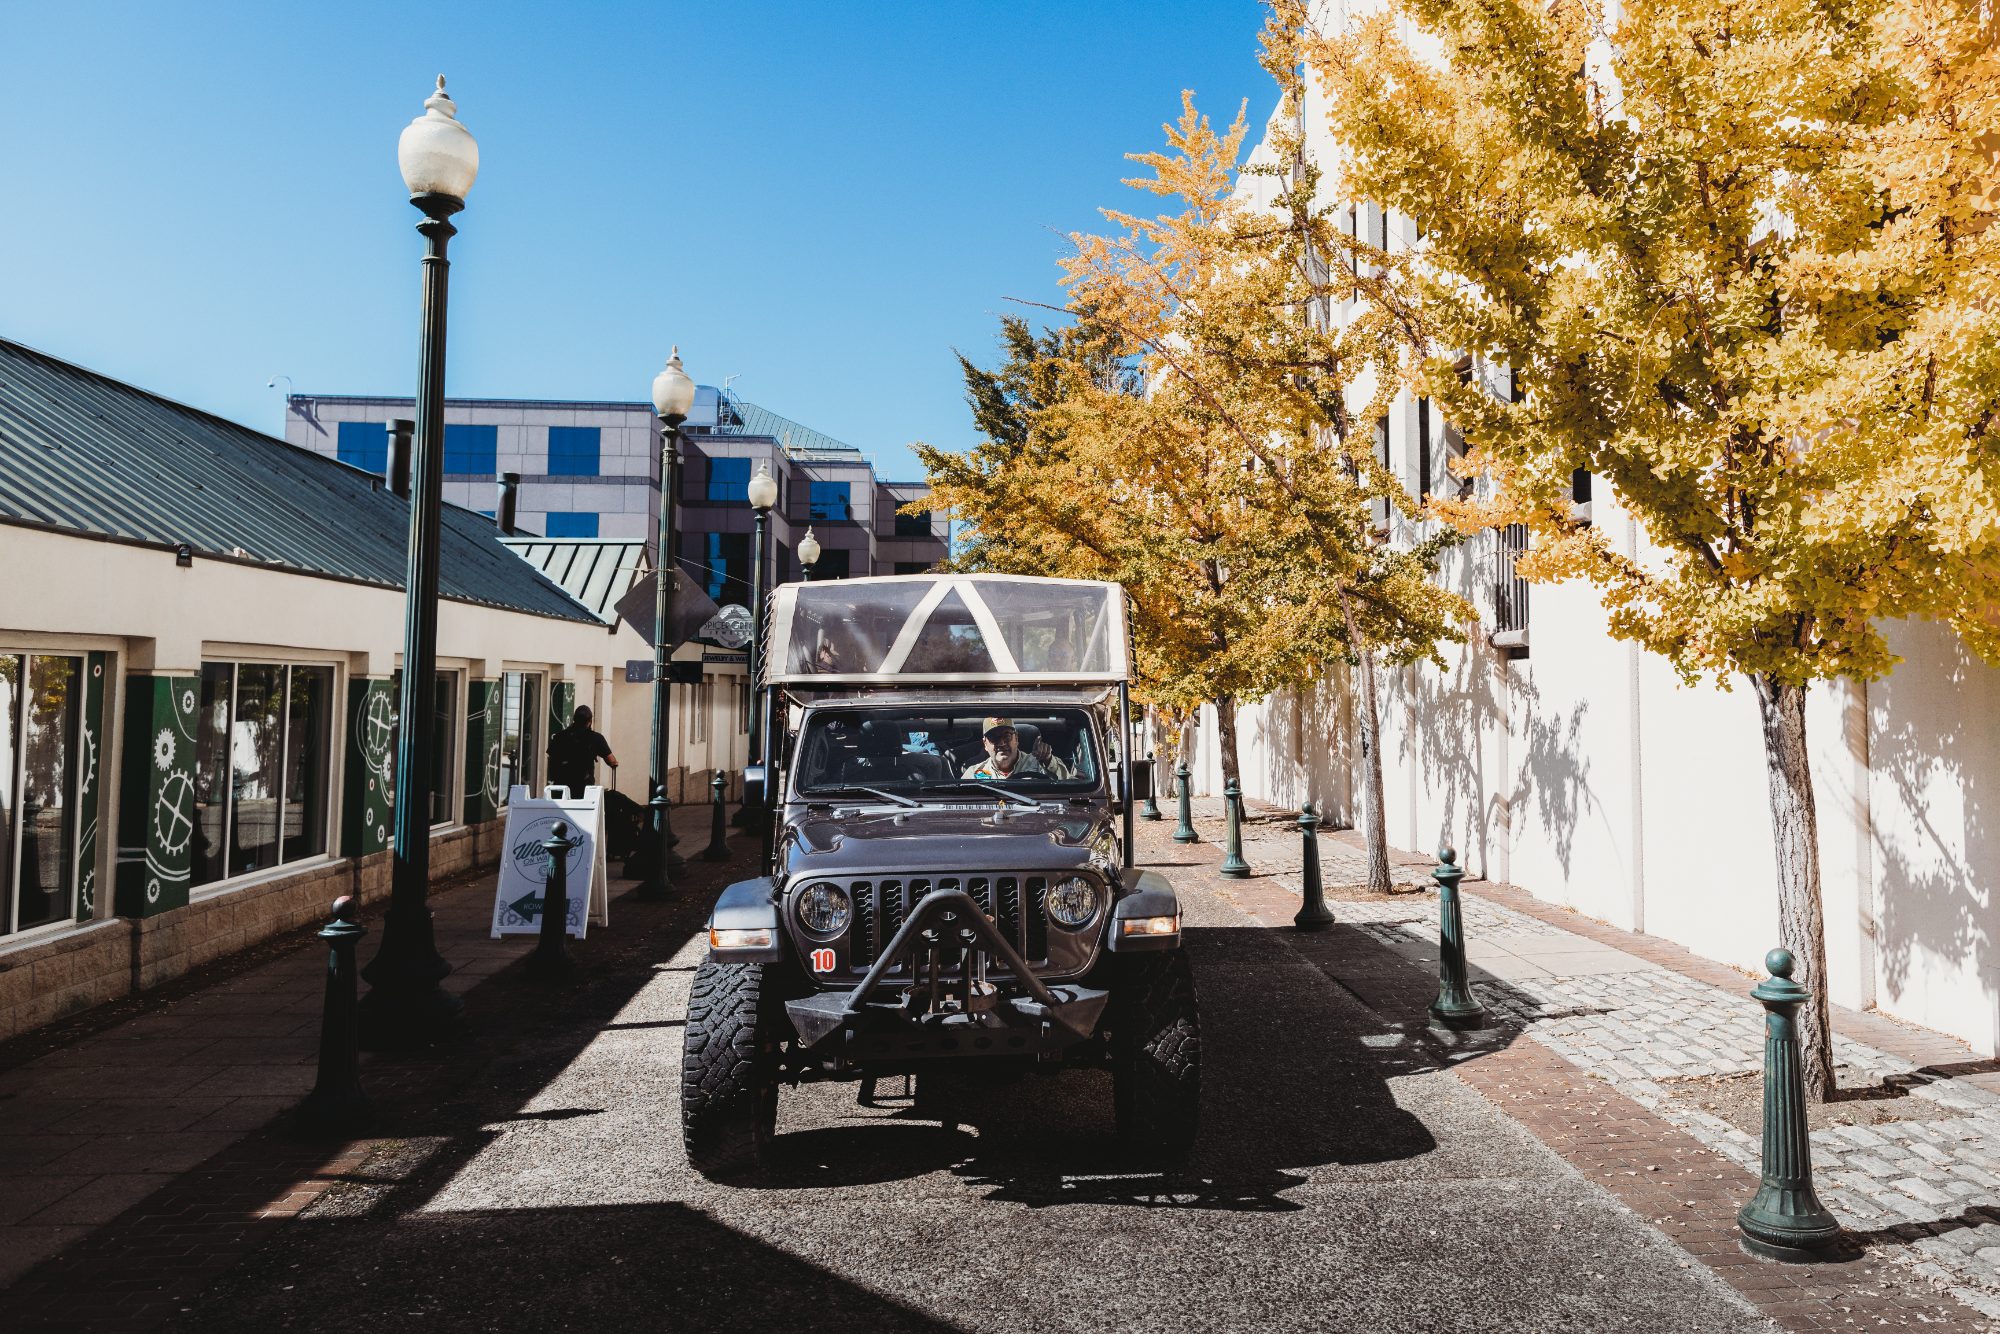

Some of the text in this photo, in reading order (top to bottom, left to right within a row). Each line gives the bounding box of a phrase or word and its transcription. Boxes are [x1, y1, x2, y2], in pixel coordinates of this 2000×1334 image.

[731, 621, 753, 630] GREE
[523, 857, 534, 865] ON
[811, 949, 835, 972] 10
